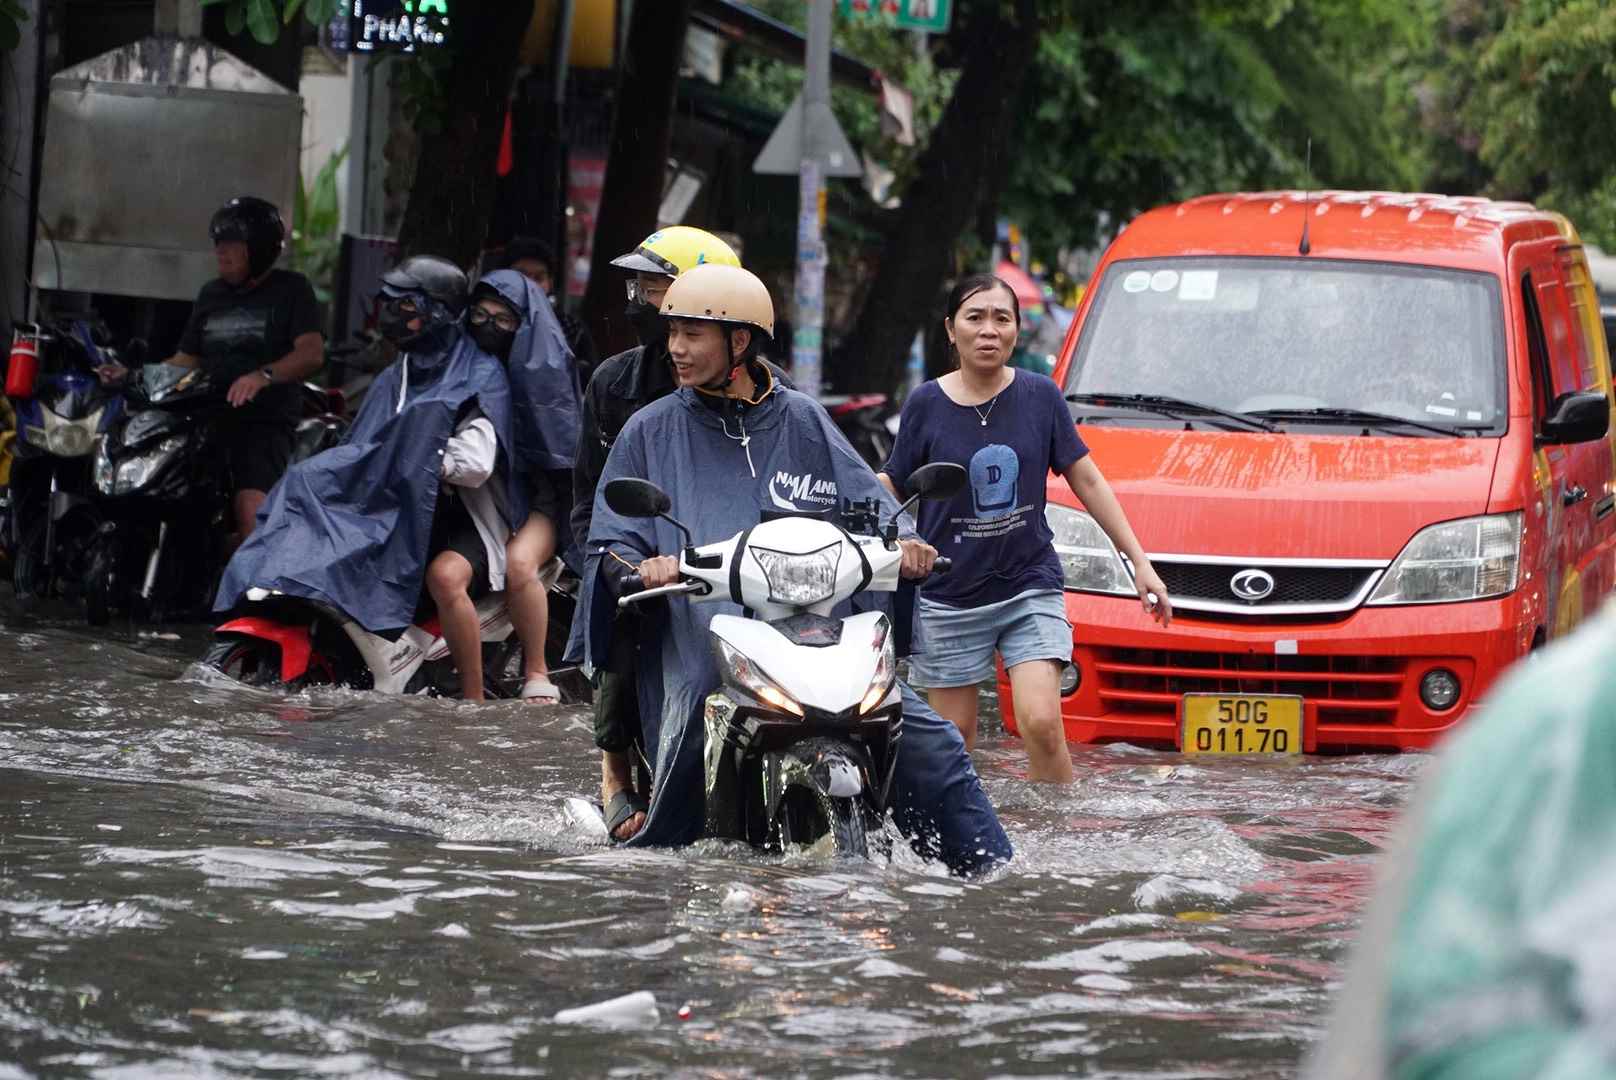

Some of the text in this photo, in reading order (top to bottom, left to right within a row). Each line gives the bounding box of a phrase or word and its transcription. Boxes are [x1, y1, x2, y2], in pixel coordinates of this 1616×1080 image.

[986, 465, 1002, 485] D
[1218, 700, 1268, 724] 50G
[1197, 727, 1287, 752] 011.70
